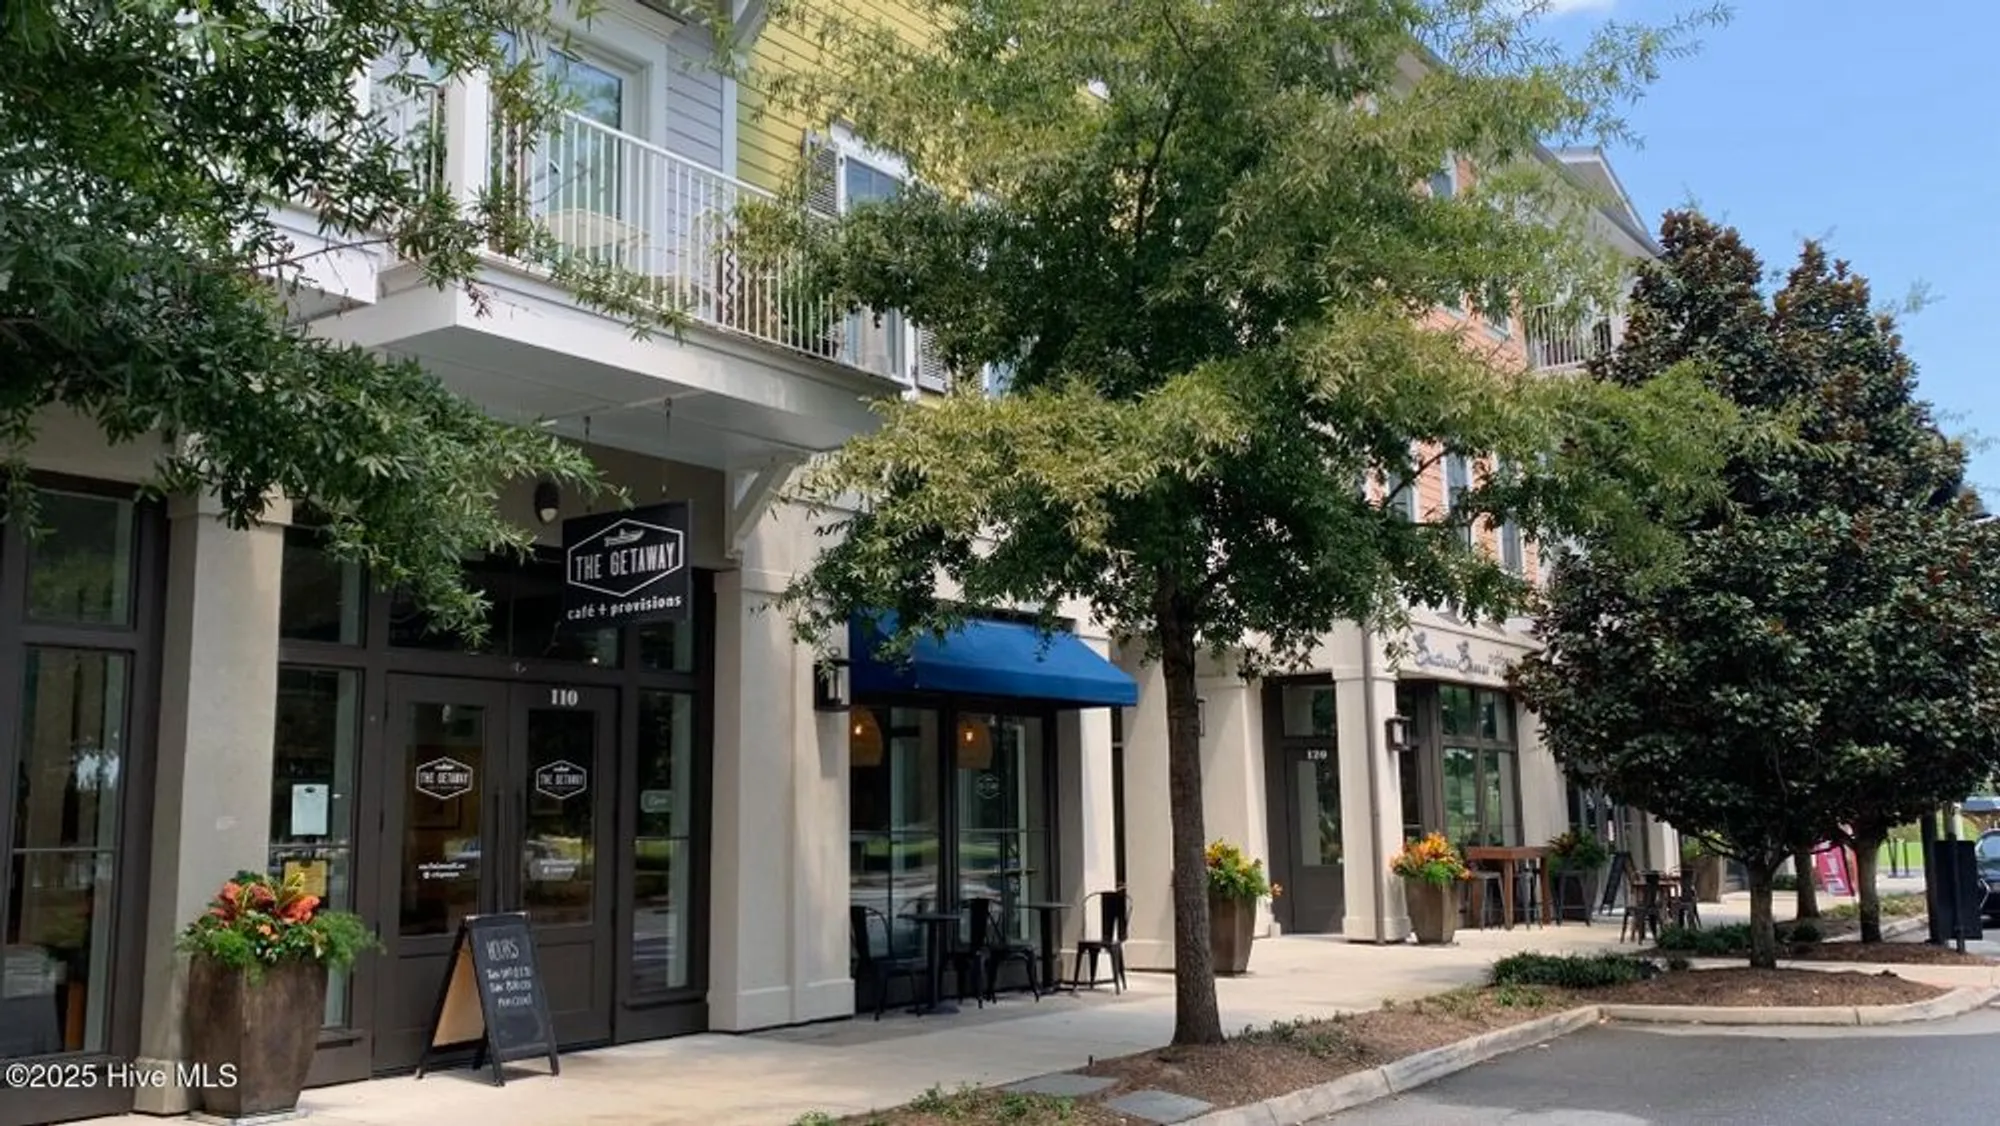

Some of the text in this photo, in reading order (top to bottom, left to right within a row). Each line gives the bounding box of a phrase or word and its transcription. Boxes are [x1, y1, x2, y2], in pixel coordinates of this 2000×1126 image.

[575, 541, 676, 581] THE GETAWAY
[567, 603, 596, 620] café
[610, 596, 682, 617] provisions
[551, 689, 579, 706] 110
